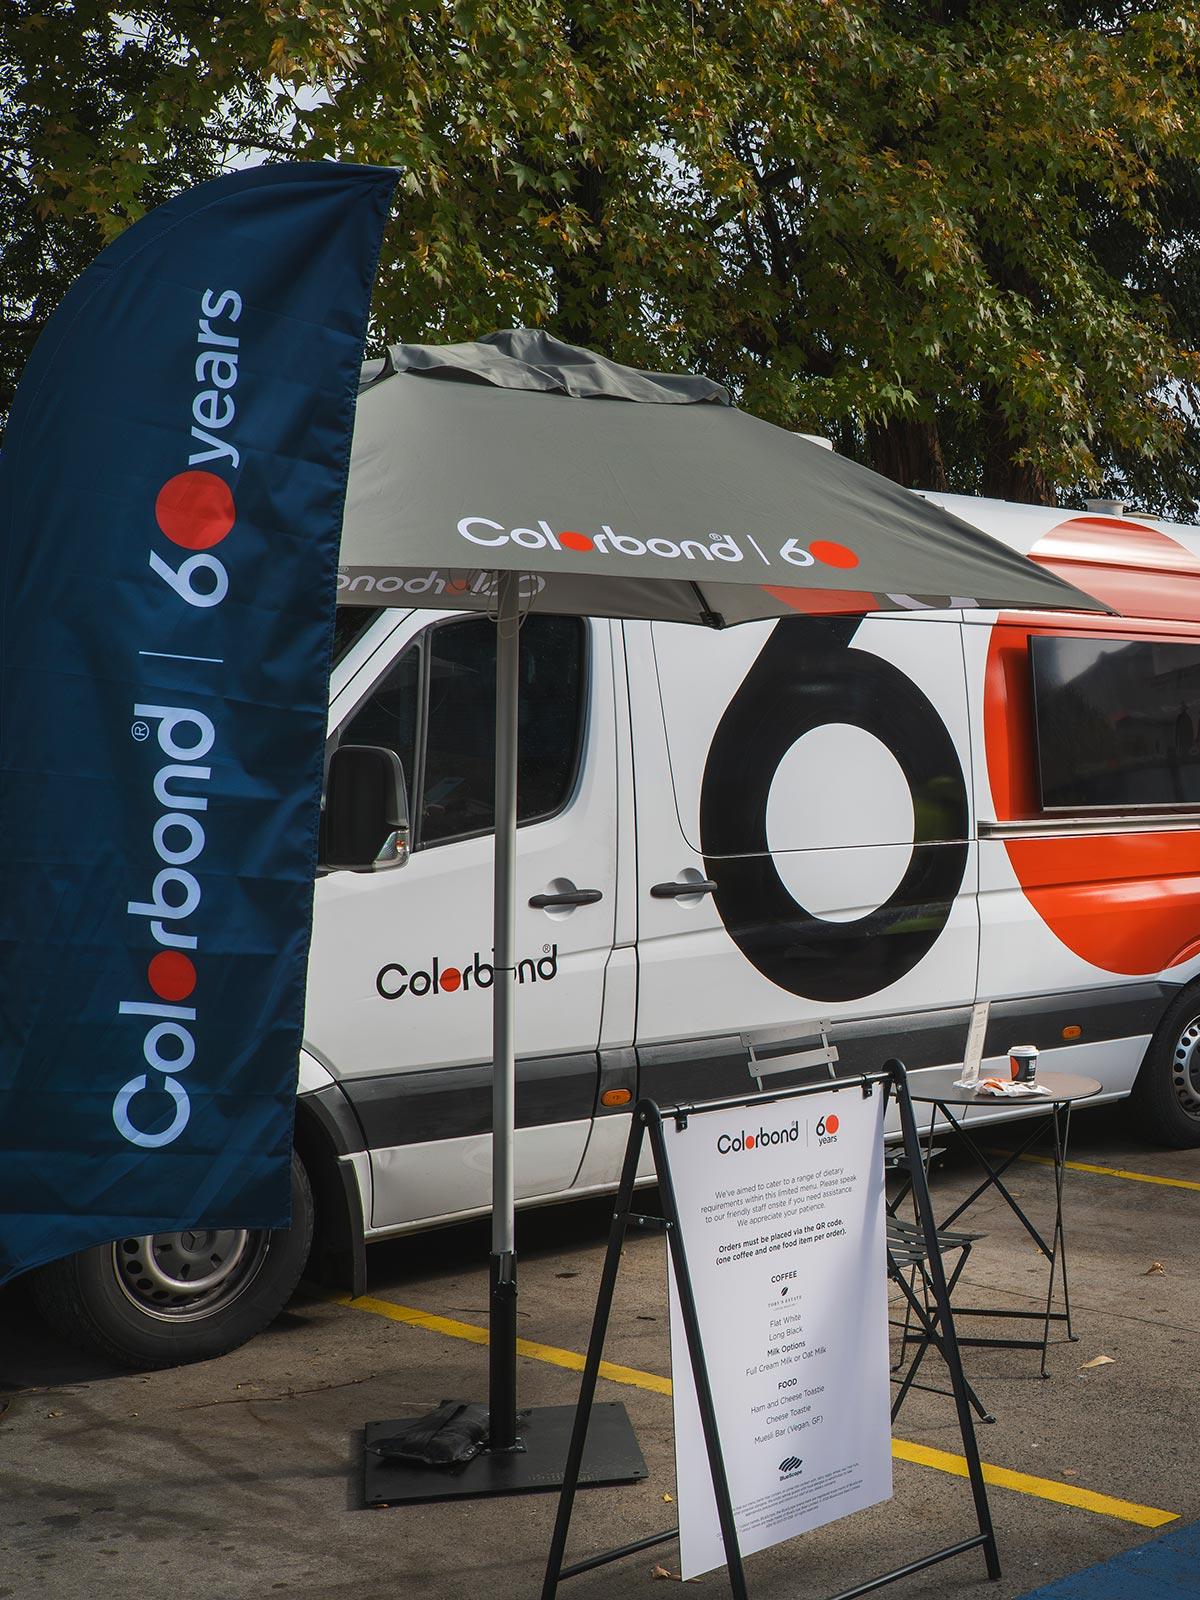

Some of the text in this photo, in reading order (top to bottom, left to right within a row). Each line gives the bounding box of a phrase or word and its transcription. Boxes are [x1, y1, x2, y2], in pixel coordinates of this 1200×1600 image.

[818, 1135, 838, 1147] years
[736, 1183, 756, 1195] aimed
[757, 1182, 765, 1191] to
[766, 1180, 782, 1189] cater
[783, 1178, 790, 1186] to
[796, 1174, 814, 1183] range
[815, 1171, 822, 1180] of
[823, 1168, 844, 1178] dietary
[700, 1198, 743, 1214] requirements
[745, 1193, 764, 1204] within
[765, 1191, 776, 1200] this
[778, 1185, 799, 1197] limited
[820, 1179, 839, 1189] Please
[840, 1173, 857, 1185] speak
[705, 1215, 712, 1223] to
[727, 1207, 750, 1219] friendly
[752, 1203, 766, 1214] staff
[768, 1200, 786, 1210] onsite
[794, 1197, 805, 1207] you
[806, 1192, 821, 1202] need
[737, 1218, 748, 1227] We
[749, 1211, 782, 1226] appreciate
[784, 1209, 798, 1219] your
[719, 1218, 844, 1253] Orders must be placed via the QR code.
[716, 1256, 731, 1267] (one
[732, 1251, 754, 1261] coffee
[755, 1246, 767, 1256] and
[768, 1245, 781, 1253] one
[782, 1239, 797, 1250] food
[798, 1237, 813, 1246] item
[814, 1234, 825, 1244] per
[771, 1271, 798, 1284] COFFEE
[770, 1314, 802, 1329] Flat White
[768, 1326, 803, 1341] Long Black
[746, 1345, 827, 1377] Full Cream Milk or Oat Milk
[767, 1342, 806, 1357] Milk Options
[778, 1378, 798, 1390] FOOD
[751, 1386, 825, 1415] Ham and Cheese Toastie
[766, 1406, 812, 1425] Cheese Toastie
[754, 1431, 774, 1444] Muesli
[775, 1429, 786, 1438] Bar
[811, 1416, 824, 1427] GF)
